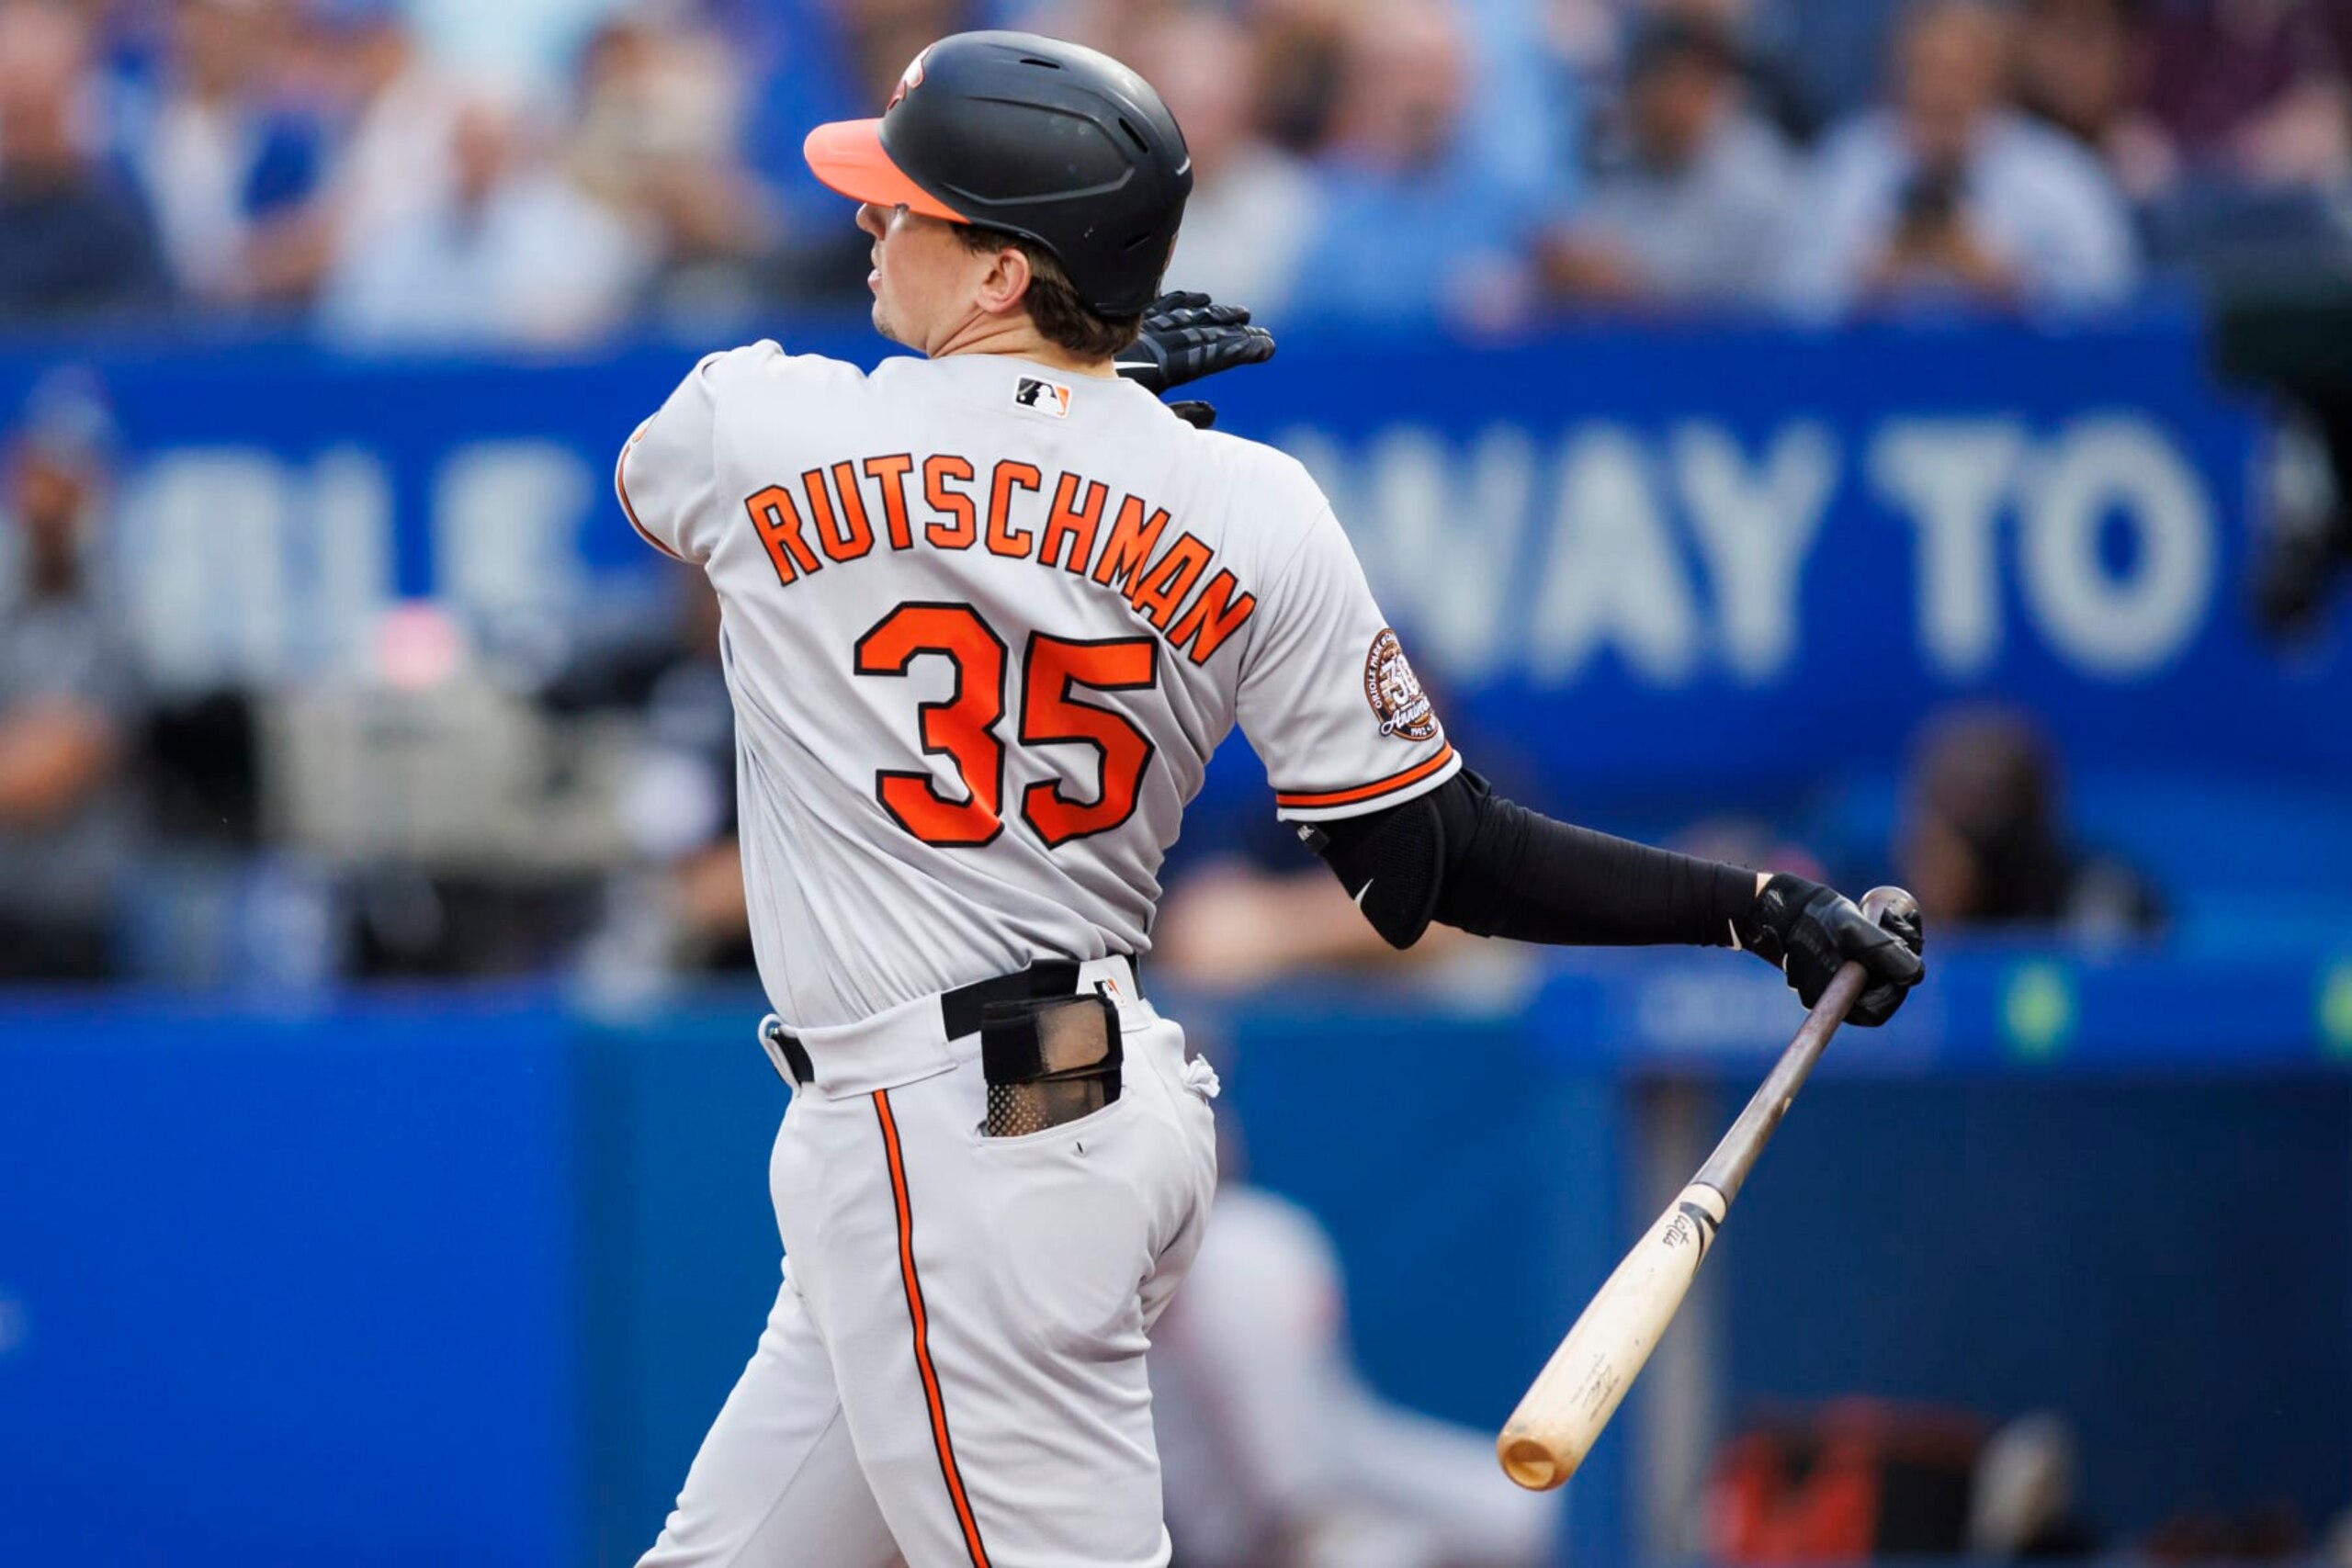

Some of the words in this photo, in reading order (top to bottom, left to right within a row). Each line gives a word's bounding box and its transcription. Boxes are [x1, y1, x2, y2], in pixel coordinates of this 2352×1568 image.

[744, 453, 1257, 666] RUTSCHMAN
[1870, 409, 2214, 682] TO
[854, 601, 1159, 850] 35
